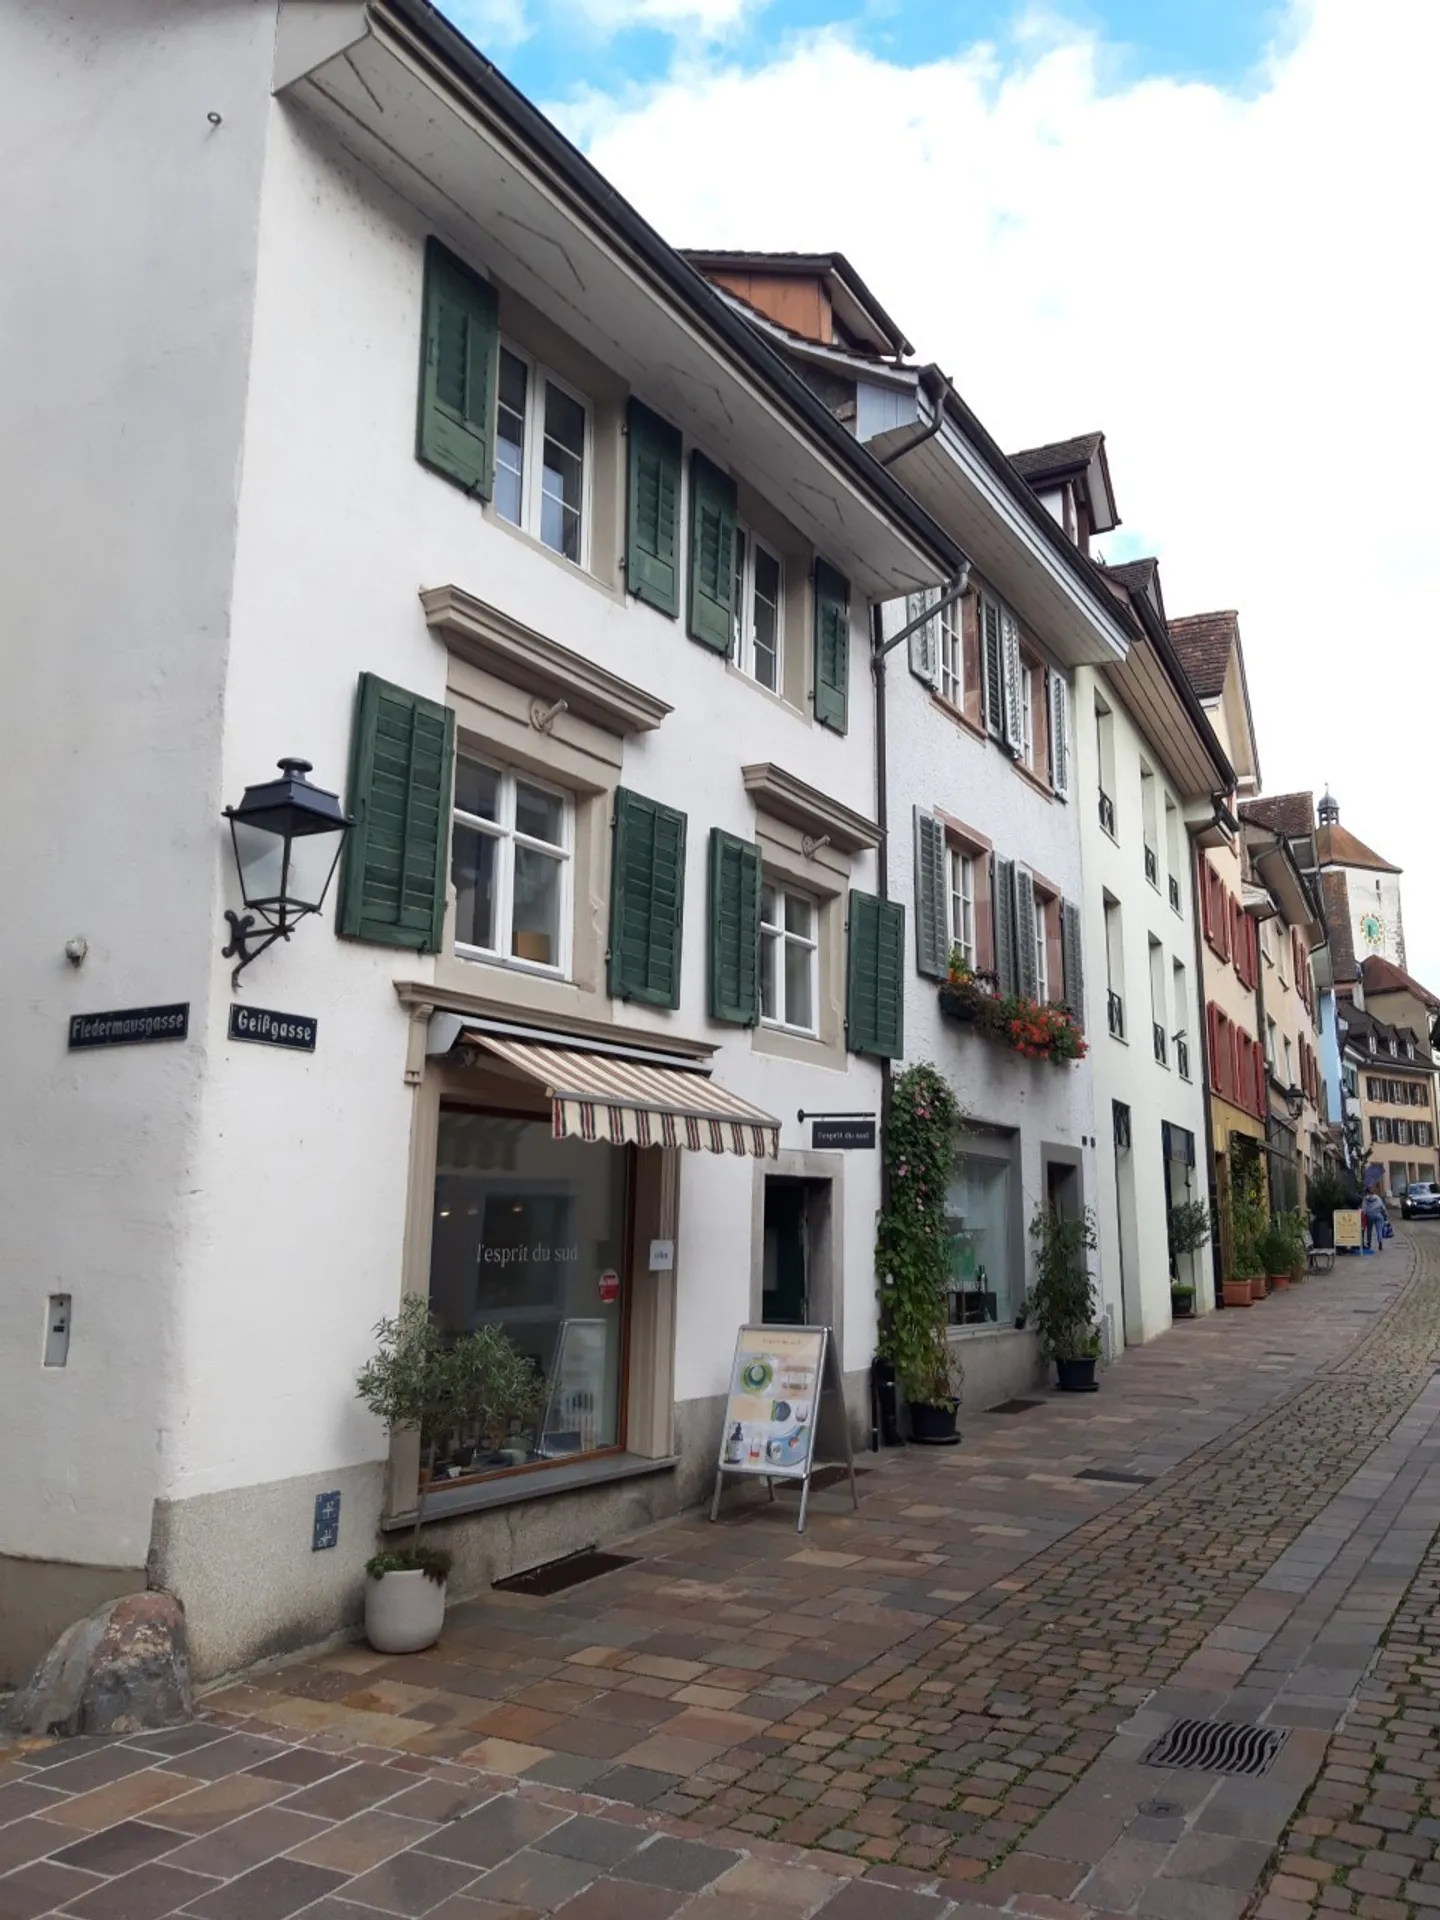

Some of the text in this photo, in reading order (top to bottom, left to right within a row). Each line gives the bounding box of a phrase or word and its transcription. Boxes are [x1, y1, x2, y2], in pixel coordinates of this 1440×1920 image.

[72, 1013, 184, 1039] Fledermausgasse
[238, 1009, 312, 1040] Geißgasse
[477, 1243, 578, 1268] l'esprit du sud
